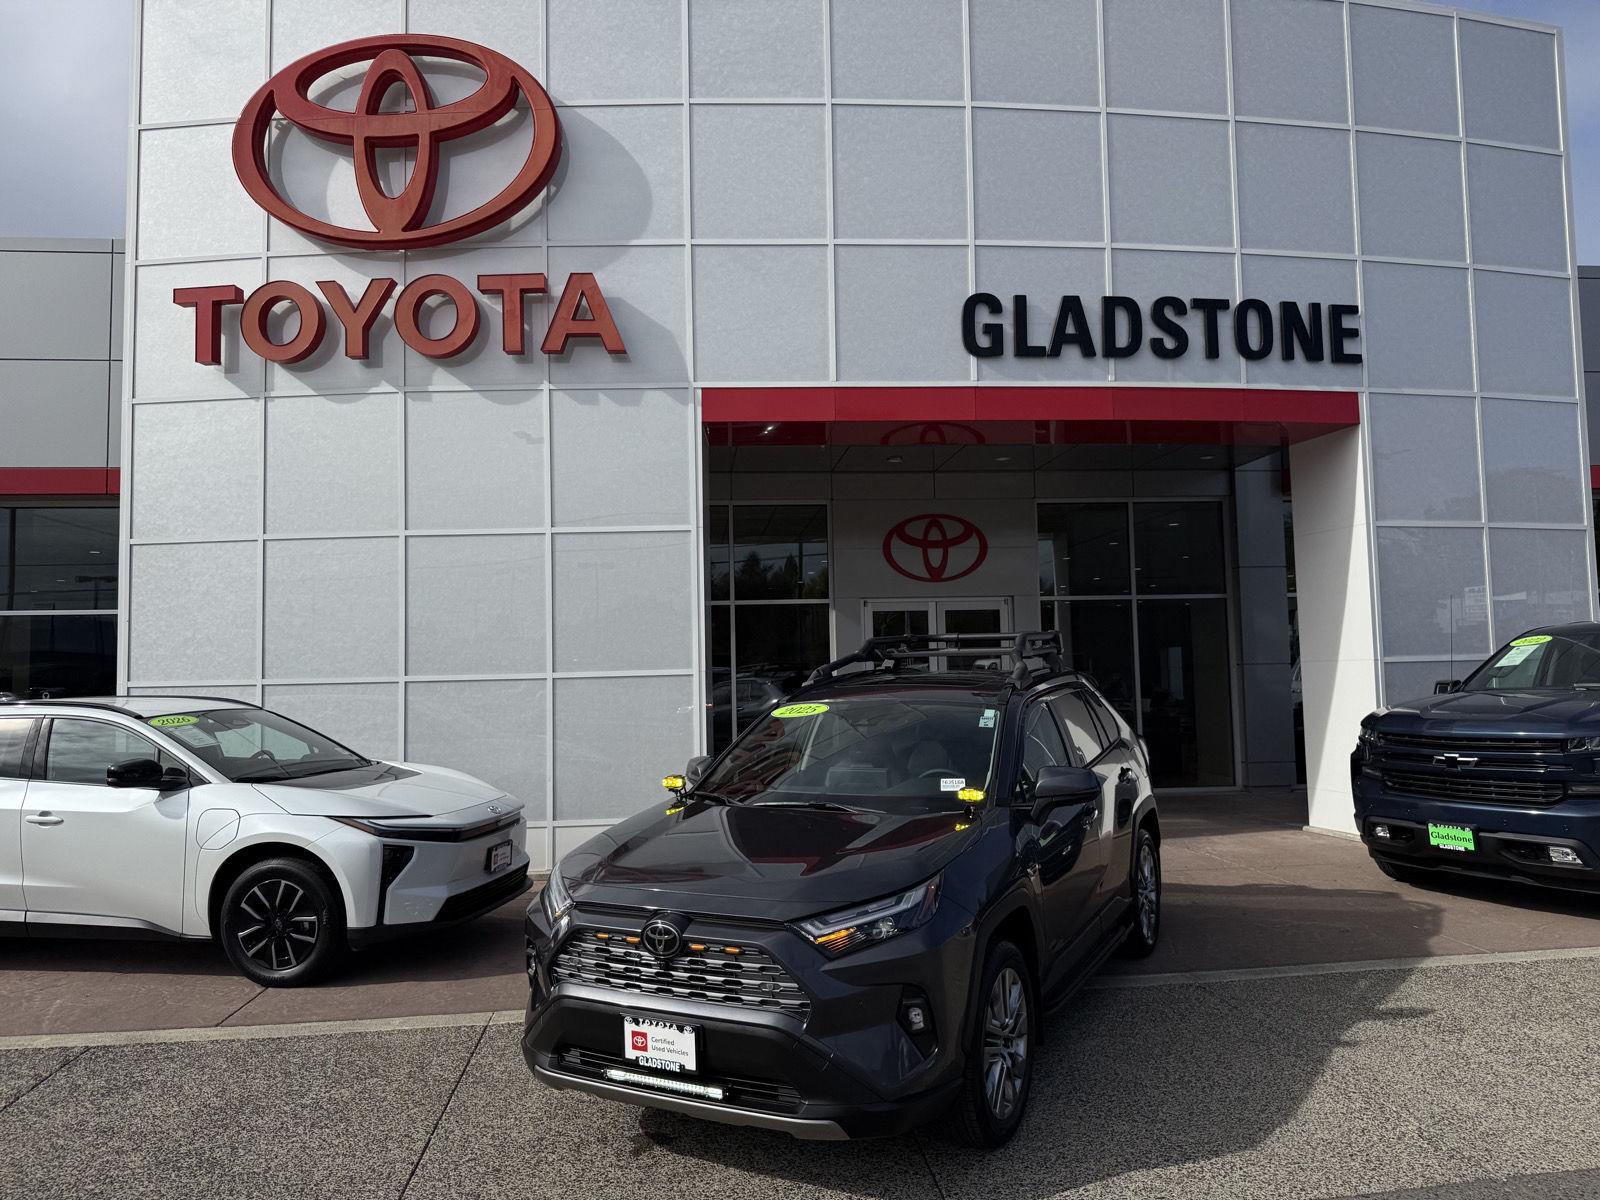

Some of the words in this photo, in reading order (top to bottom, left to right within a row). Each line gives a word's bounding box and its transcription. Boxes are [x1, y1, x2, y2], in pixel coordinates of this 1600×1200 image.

[173, 272, 628, 366] TOYOTA
[961, 292, 1363, 364] GLADSTONE
[779, 704, 822, 715] 2025
[157, 716, 191, 726] 2026
[1430, 830, 1473, 844] Gladstone
[638, 1018, 678, 1031] TOYOTA
[651, 1036, 675, 1046] Certified
[651, 1045, 666, 1053] Used
[666, 1046, 689, 1057] Vehicles
[638, 1055, 682, 1072] GLADSTONE
